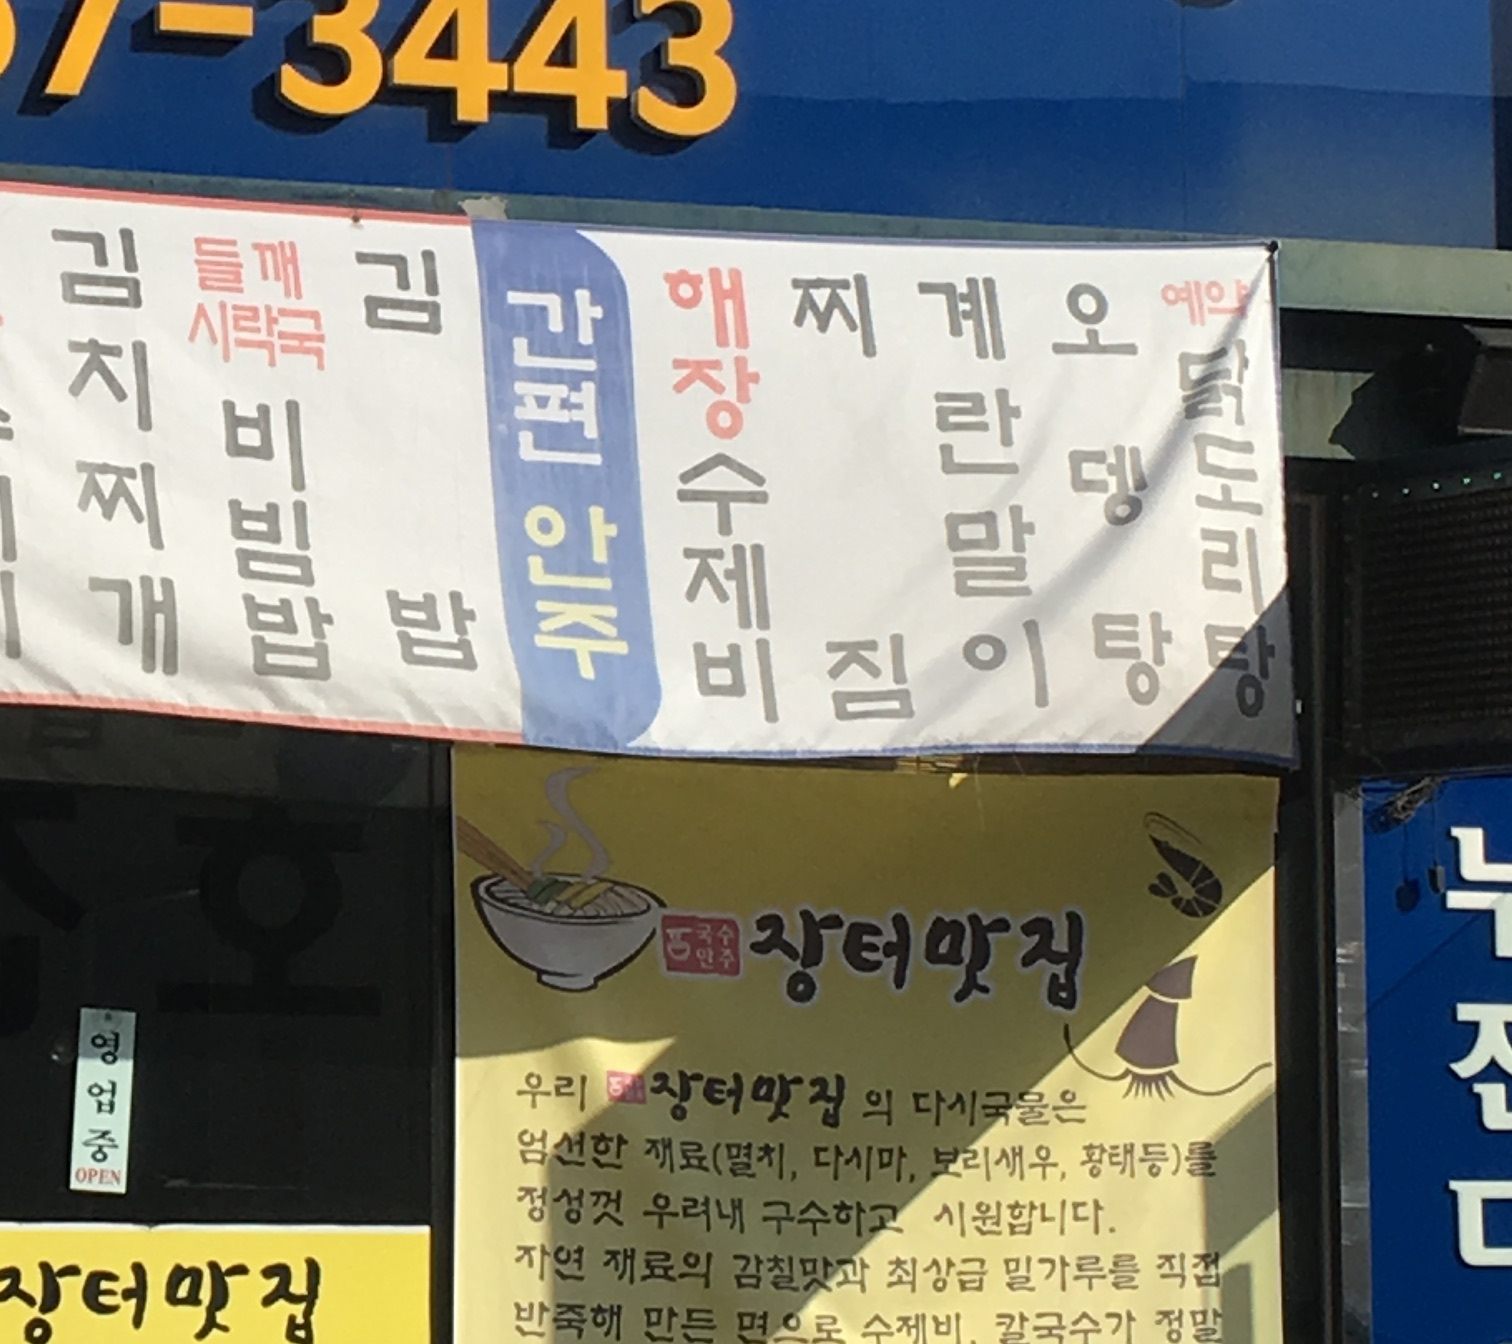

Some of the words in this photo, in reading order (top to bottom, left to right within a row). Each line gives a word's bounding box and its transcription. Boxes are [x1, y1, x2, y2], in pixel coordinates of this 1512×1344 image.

[506, 290, 603, 466] 간편
[51, 228, 178, 675] 김치찌개
[918, 276, 1050, 708] 계란말이
[1052, 283, 1173, 706] 오뎅탕
[523, 505, 629, 682] 안주
[750, 910, 1085, 1009] 장터맛집
[517, 1071, 587, 1111] 우리
[862, 1088, 893, 1126] 의
[913, 1088, 1087, 1127] 다시국물은
[75, 1167, 121, 1185] OPEN
[517, 1128, 628, 1170] 엄선한
[517, 1186, 624, 1226] 정성껏
[643, 1193, 745, 1234] 우려내
[762, 1200, 903, 1236] 구수하고
[934, 1198, 1116, 1237] 시원합니다.
[516, 1244, 585, 1282] 자연
[603, 1247, 711, 1288] 재료의
[733, 1253, 869, 1293] 감칠맛과
[886, 1256, 988, 1293] 최상급
[1003, 1253, 1140, 1292] 밀가루를
[1157, 1252, 1222, 1288] 직접
[515, 1301, 623, 1341] 반죽해
[644, 1306, 716, 1344] 만든
[1155, 1308, 1223, 1344] 정말
